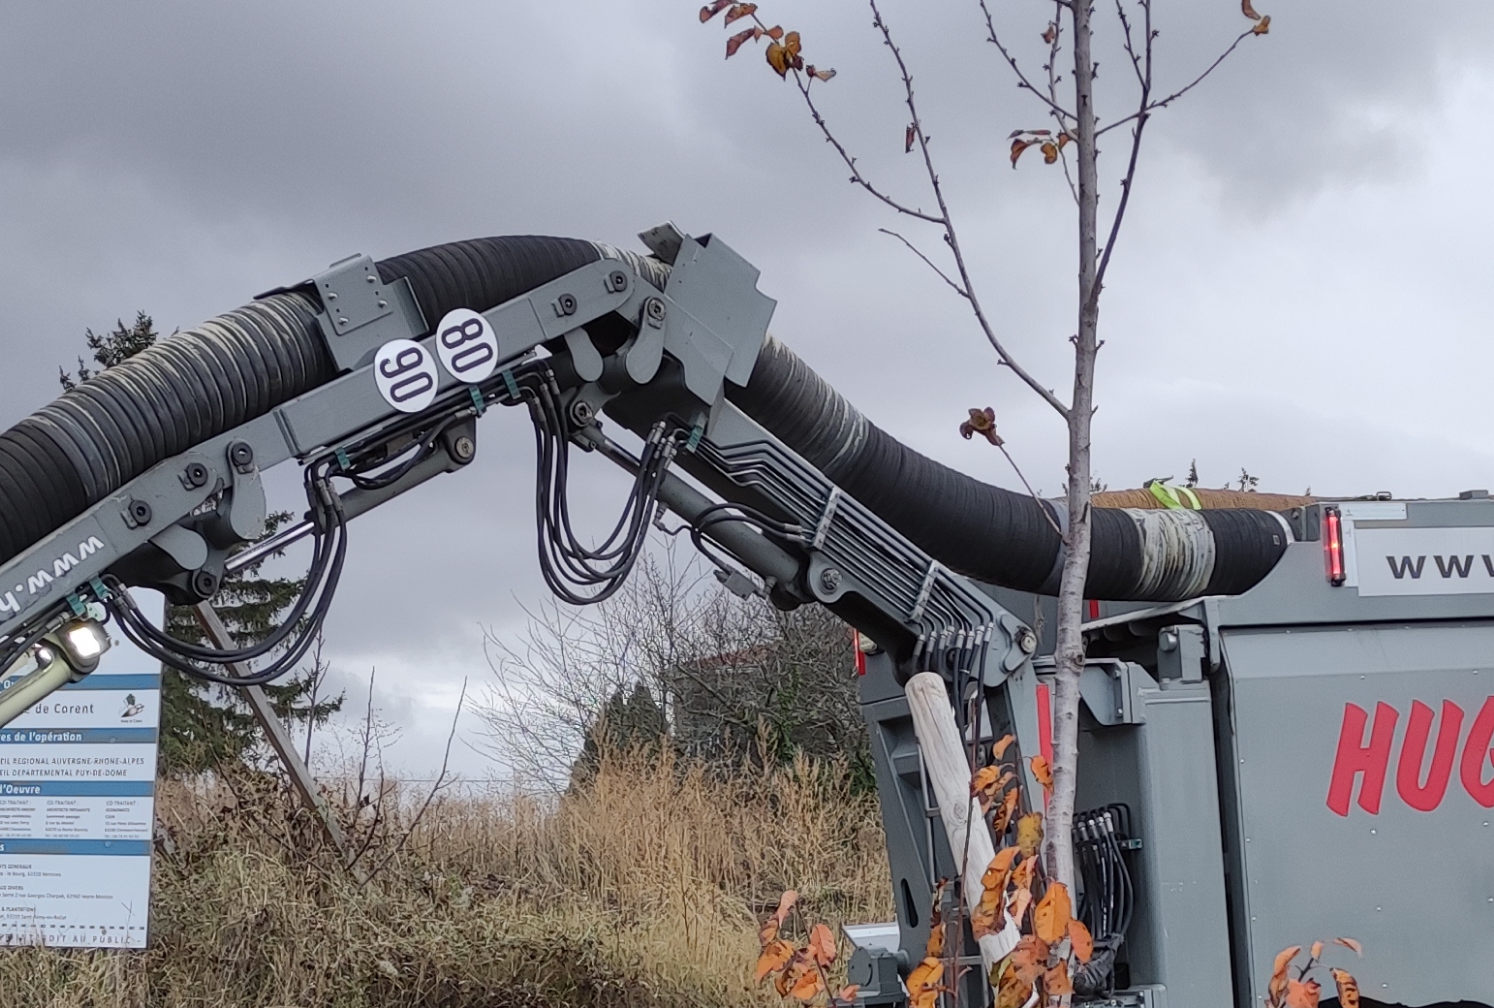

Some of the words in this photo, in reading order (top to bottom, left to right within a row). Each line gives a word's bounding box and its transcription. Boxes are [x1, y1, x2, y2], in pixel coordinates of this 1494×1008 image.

[35, 703, 49, 714] de
[54, 703, 95, 714] Corent
[14, 731, 26, 741] de
[29, 731, 83, 743] l'opération
